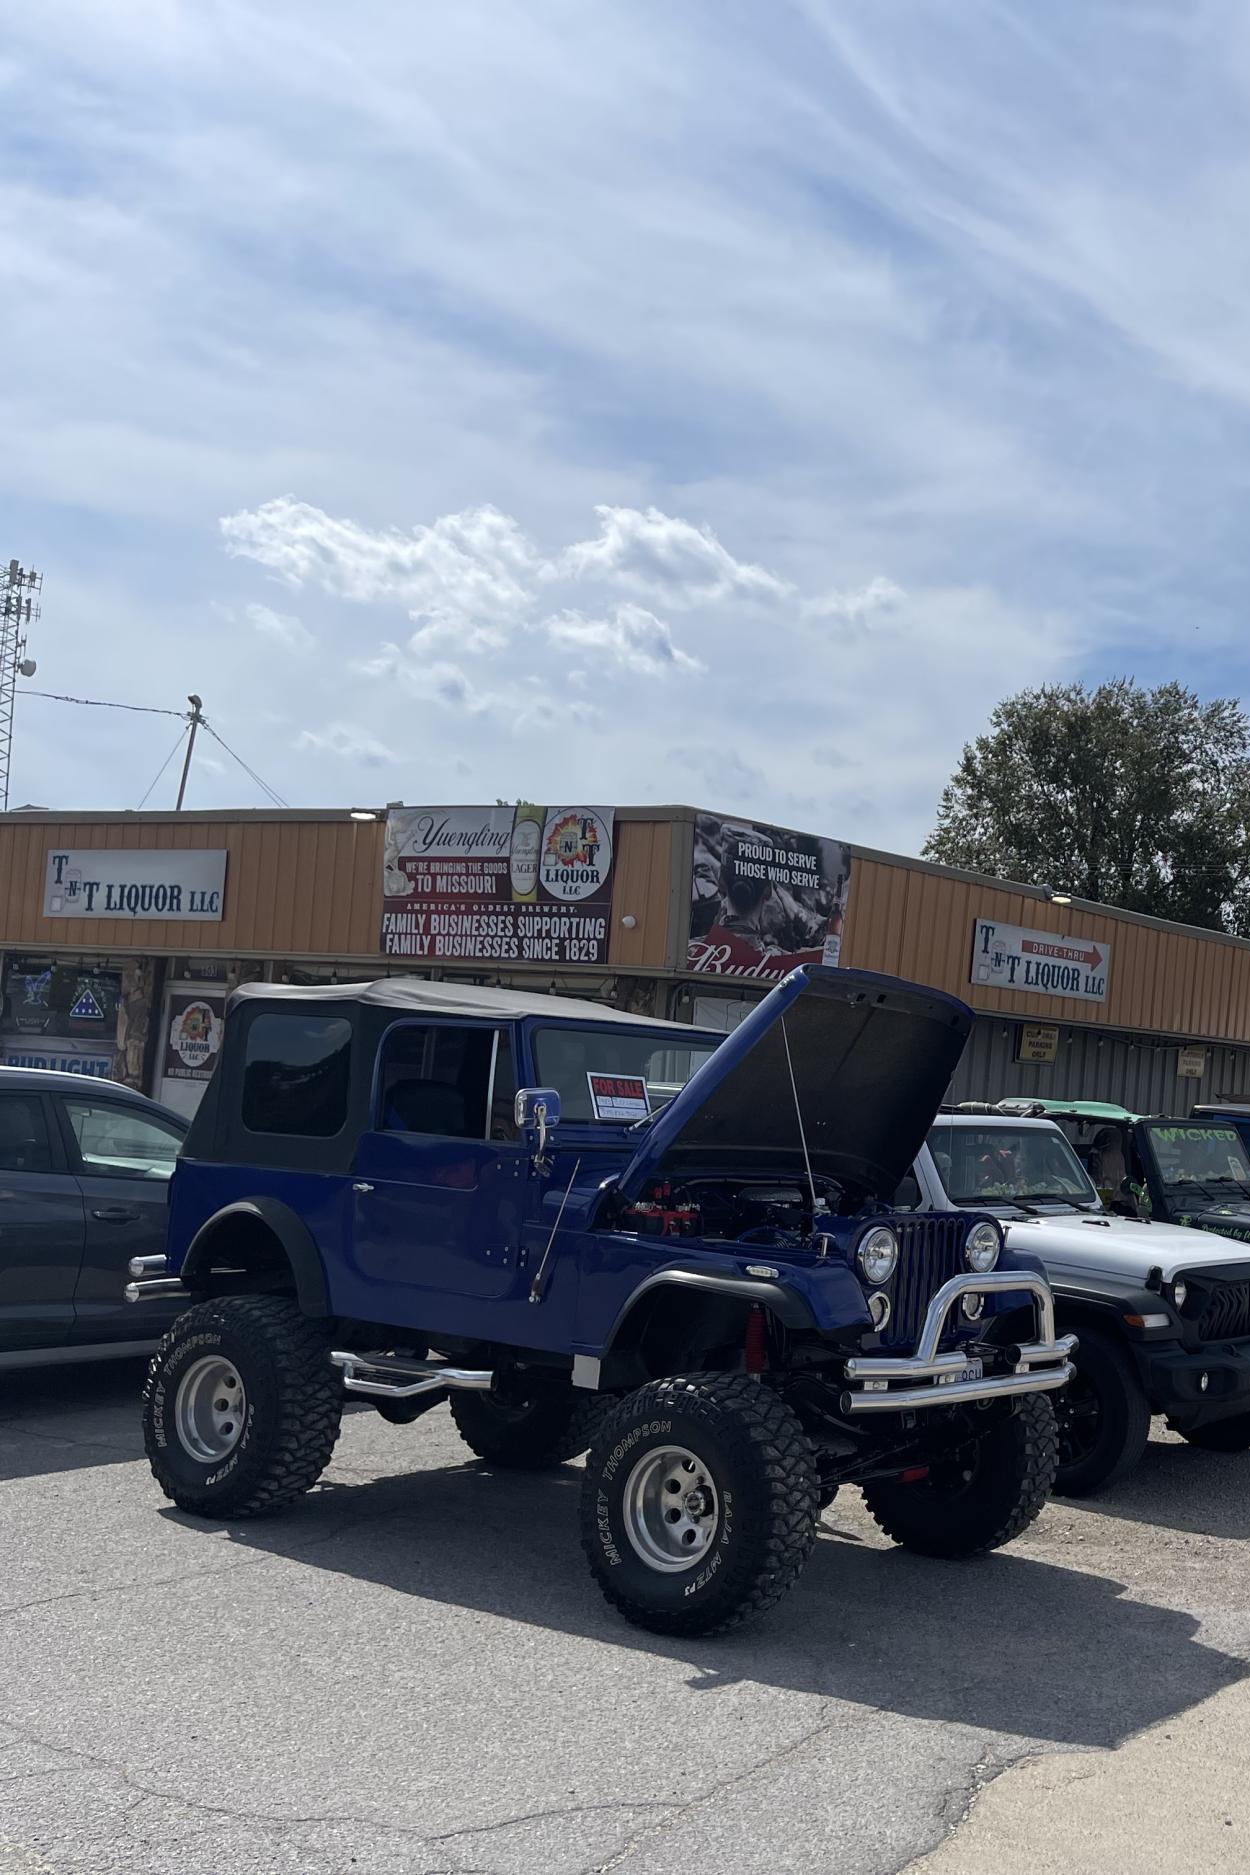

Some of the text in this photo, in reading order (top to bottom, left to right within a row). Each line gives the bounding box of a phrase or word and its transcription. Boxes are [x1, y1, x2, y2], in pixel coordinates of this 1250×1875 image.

[412, 816, 511, 855] Yuengling
[738, 842, 817, 871] PROUD TO SERVE
[405, 861, 508, 874] WE'RE BRINGING THE GOODS
[545, 869, 600, 884] LIQUOR
[734, 860, 820, 889] THOSE WHO SERVE
[416, 875, 496, 893] TO MISSOURI
[563, 886, 581, 895] LLC
[105, 884, 182, 916] LIQUOR
[189, 891, 219, 913] LLC
[406, 903, 466, 911] AMERICA'S
[473, 904, 516, 912] OLDEST
[382, 913, 606, 939] FAMILY BUSINESSES SUPPORTING
[385, 934, 599, 961] FAMILY BUSINESSES SINCE 1829
[1032, 943, 1085, 961] DRIVE-THRU
[1024, 960, 1081, 992] LIQUOR
[1083, 976, 1105, 996] LLC
[180, 1041, 210, 1052] LIQUOR
[592, 1077, 643, 1098] FOR SALE
[1151, 1127, 1238, 1142] WICKED
[1201, 1223, 1232, 1237] Protected
[1232, 1228, 1243, 1240] by
[153, 1380, 168, 1448] MICKEY
[597, 1420, 672, 1566] MICKEY THOMPSON
